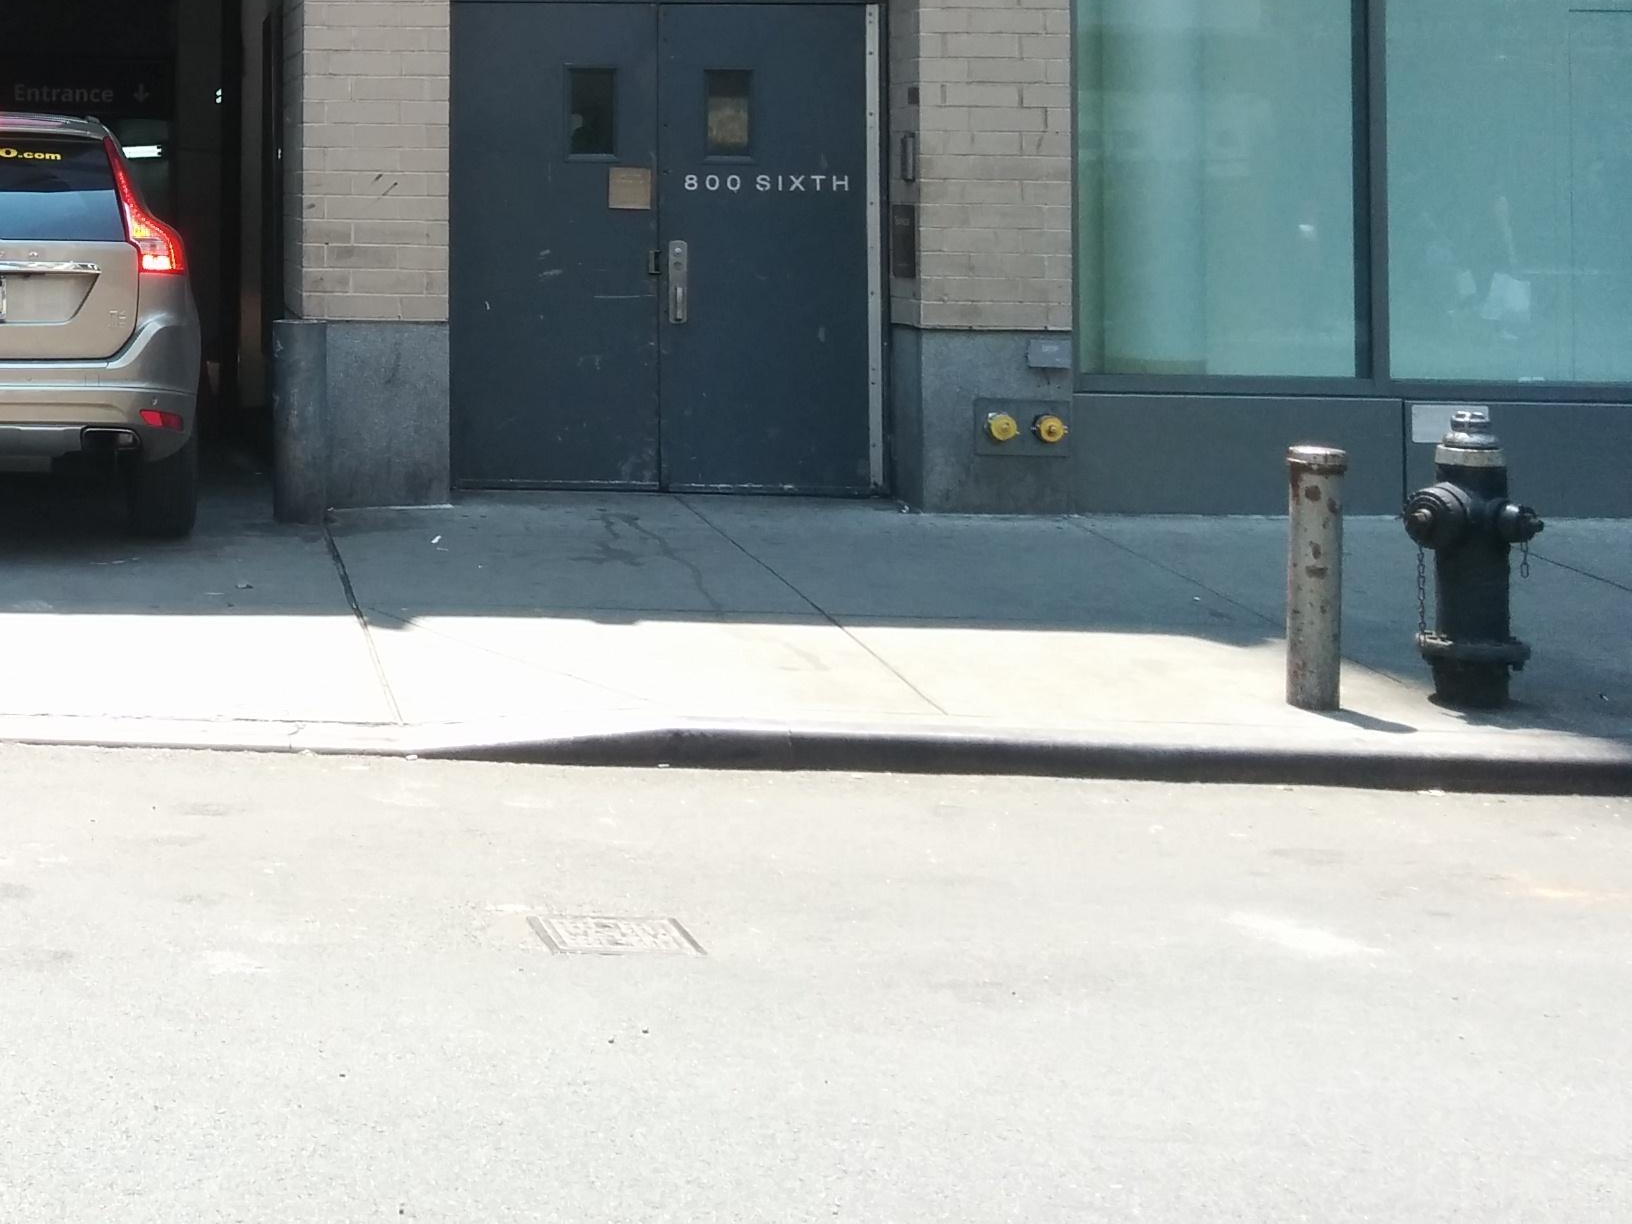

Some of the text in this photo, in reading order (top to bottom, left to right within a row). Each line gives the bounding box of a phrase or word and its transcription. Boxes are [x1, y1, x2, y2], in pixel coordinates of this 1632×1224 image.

[14, 84, 114, 103] Entrance
[684, 175, 850, 191] 800 SIXTH
